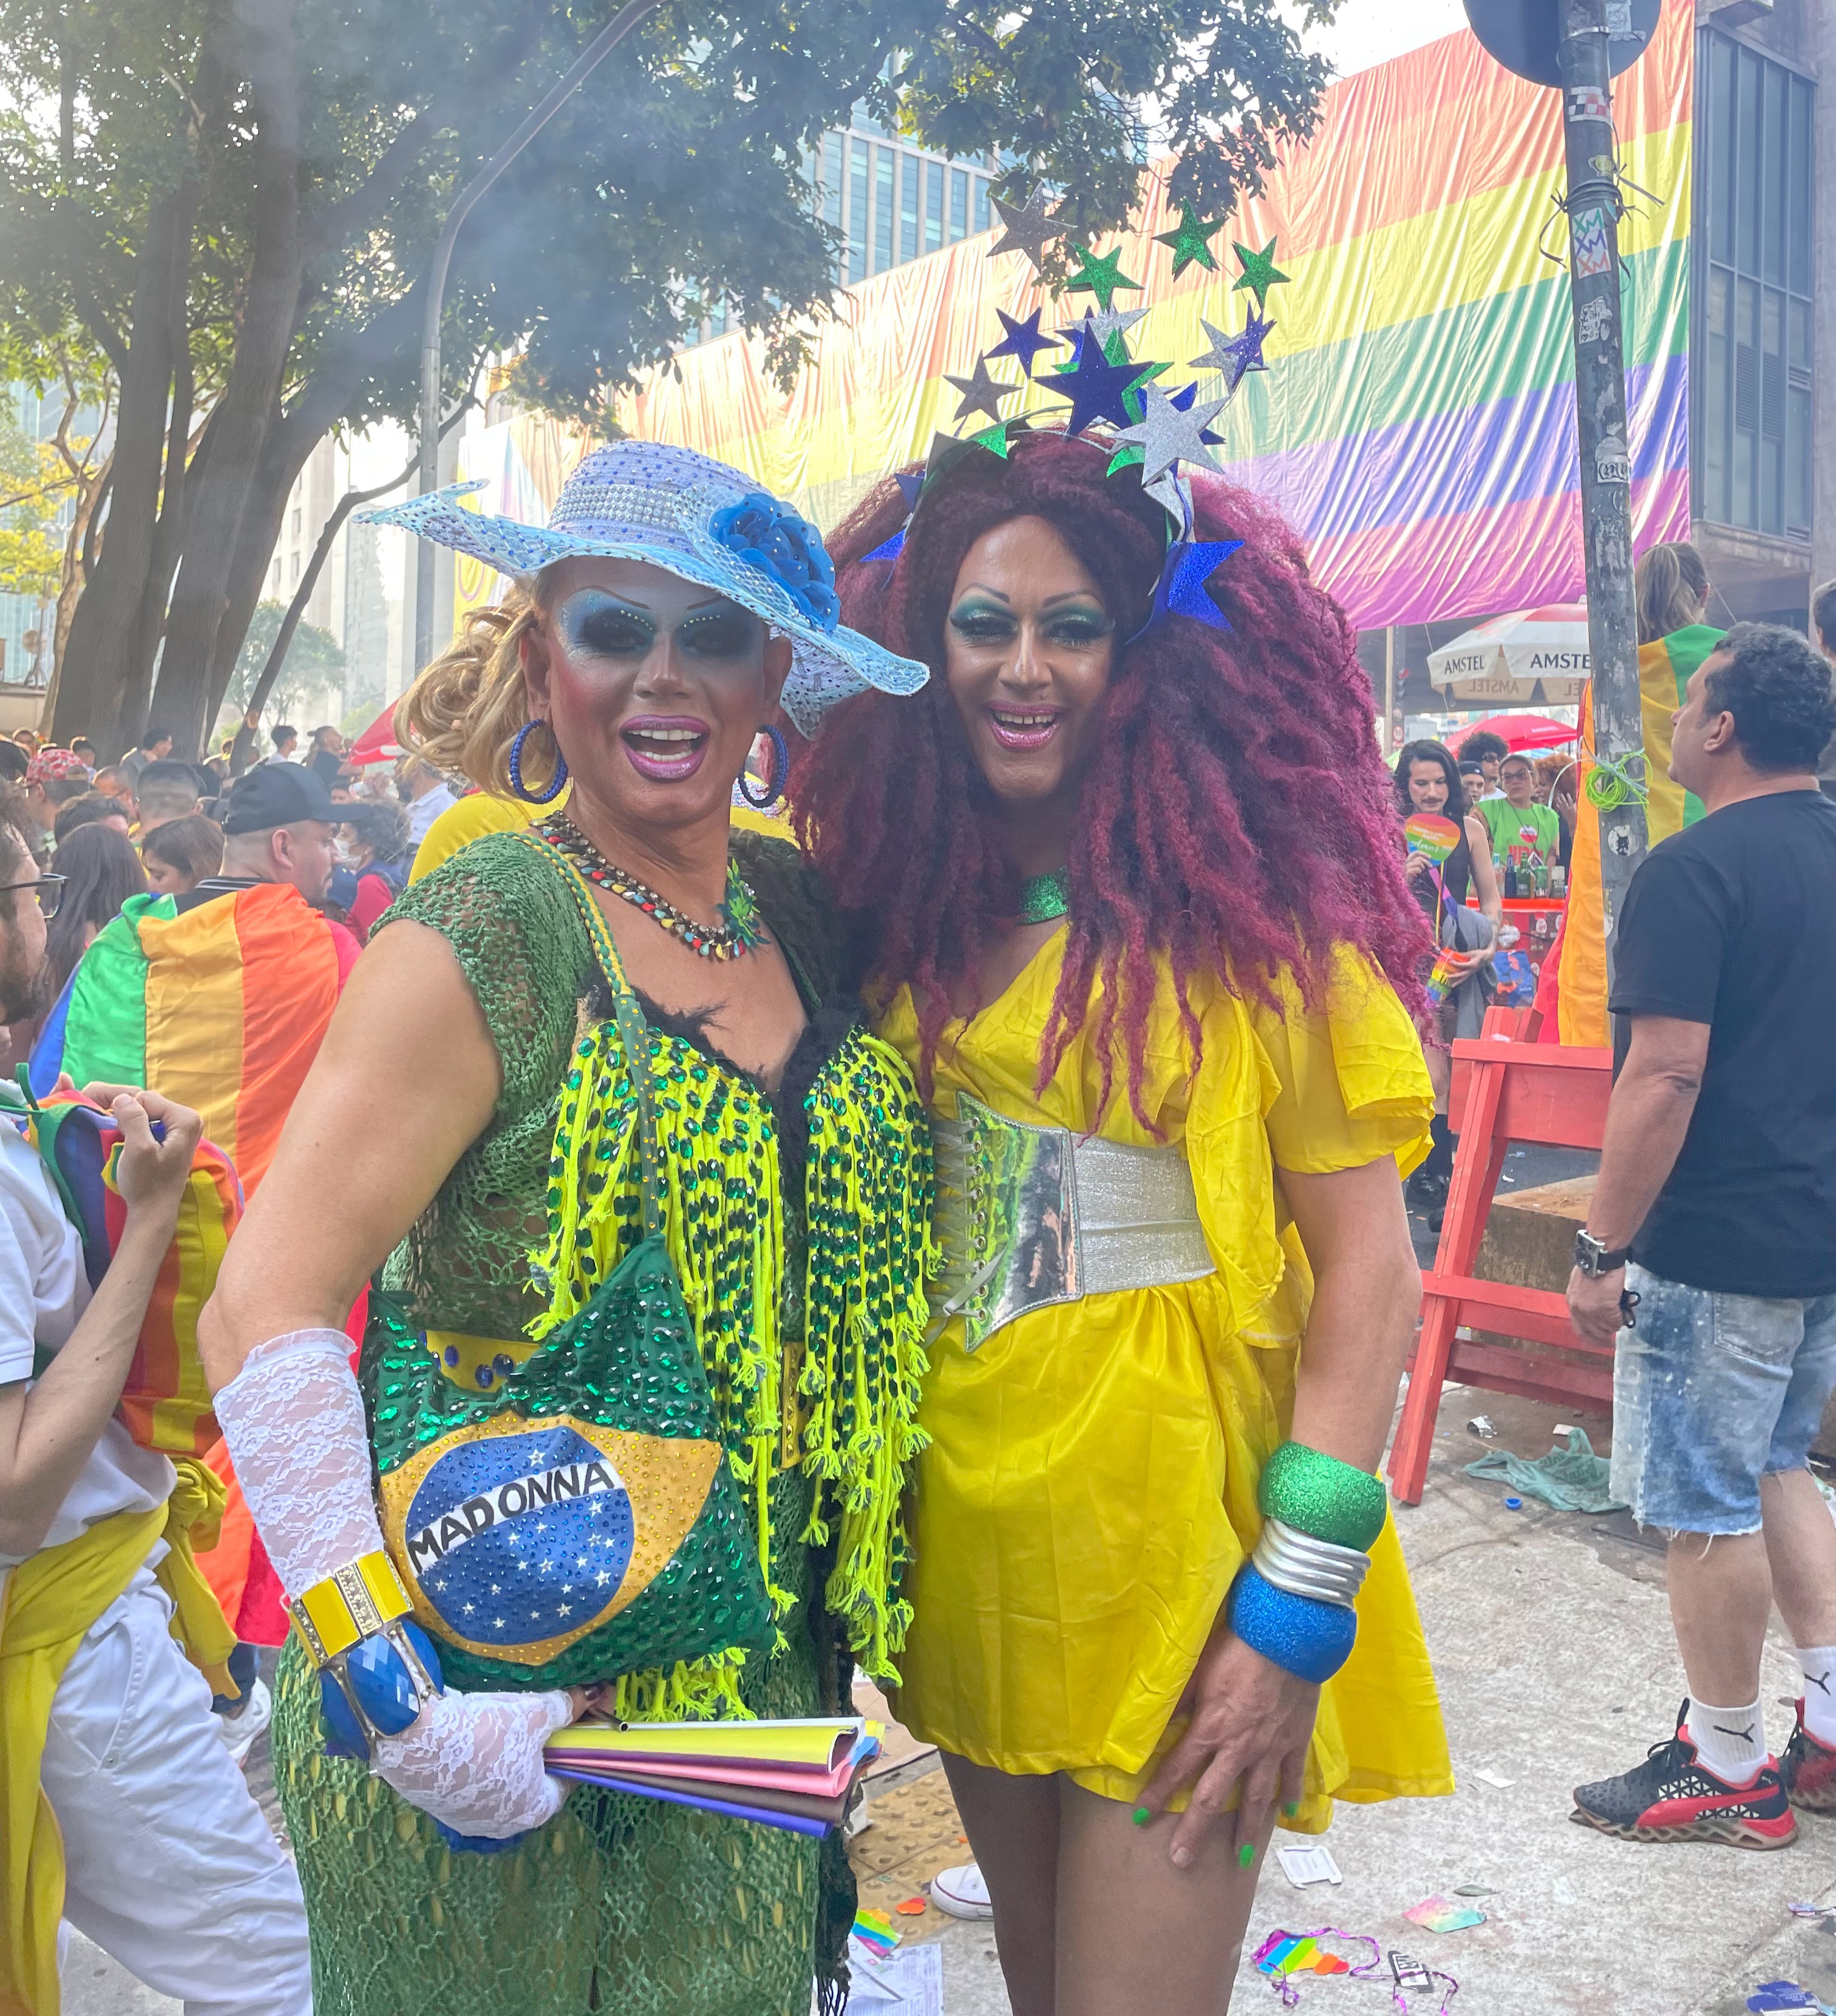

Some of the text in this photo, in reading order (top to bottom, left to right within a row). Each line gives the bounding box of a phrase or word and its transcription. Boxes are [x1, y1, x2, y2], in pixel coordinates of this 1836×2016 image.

[1573, 209, 1605, 237] XM
[1574, 229, 1607, 257] XM
[1577, 251, 1611, 277] XM
[1444, 655, 1484, 674] AMSTEL
[1531, 653, 1591, 669] AMSTE
[407, 1461, 615, 1573] MADONNA
